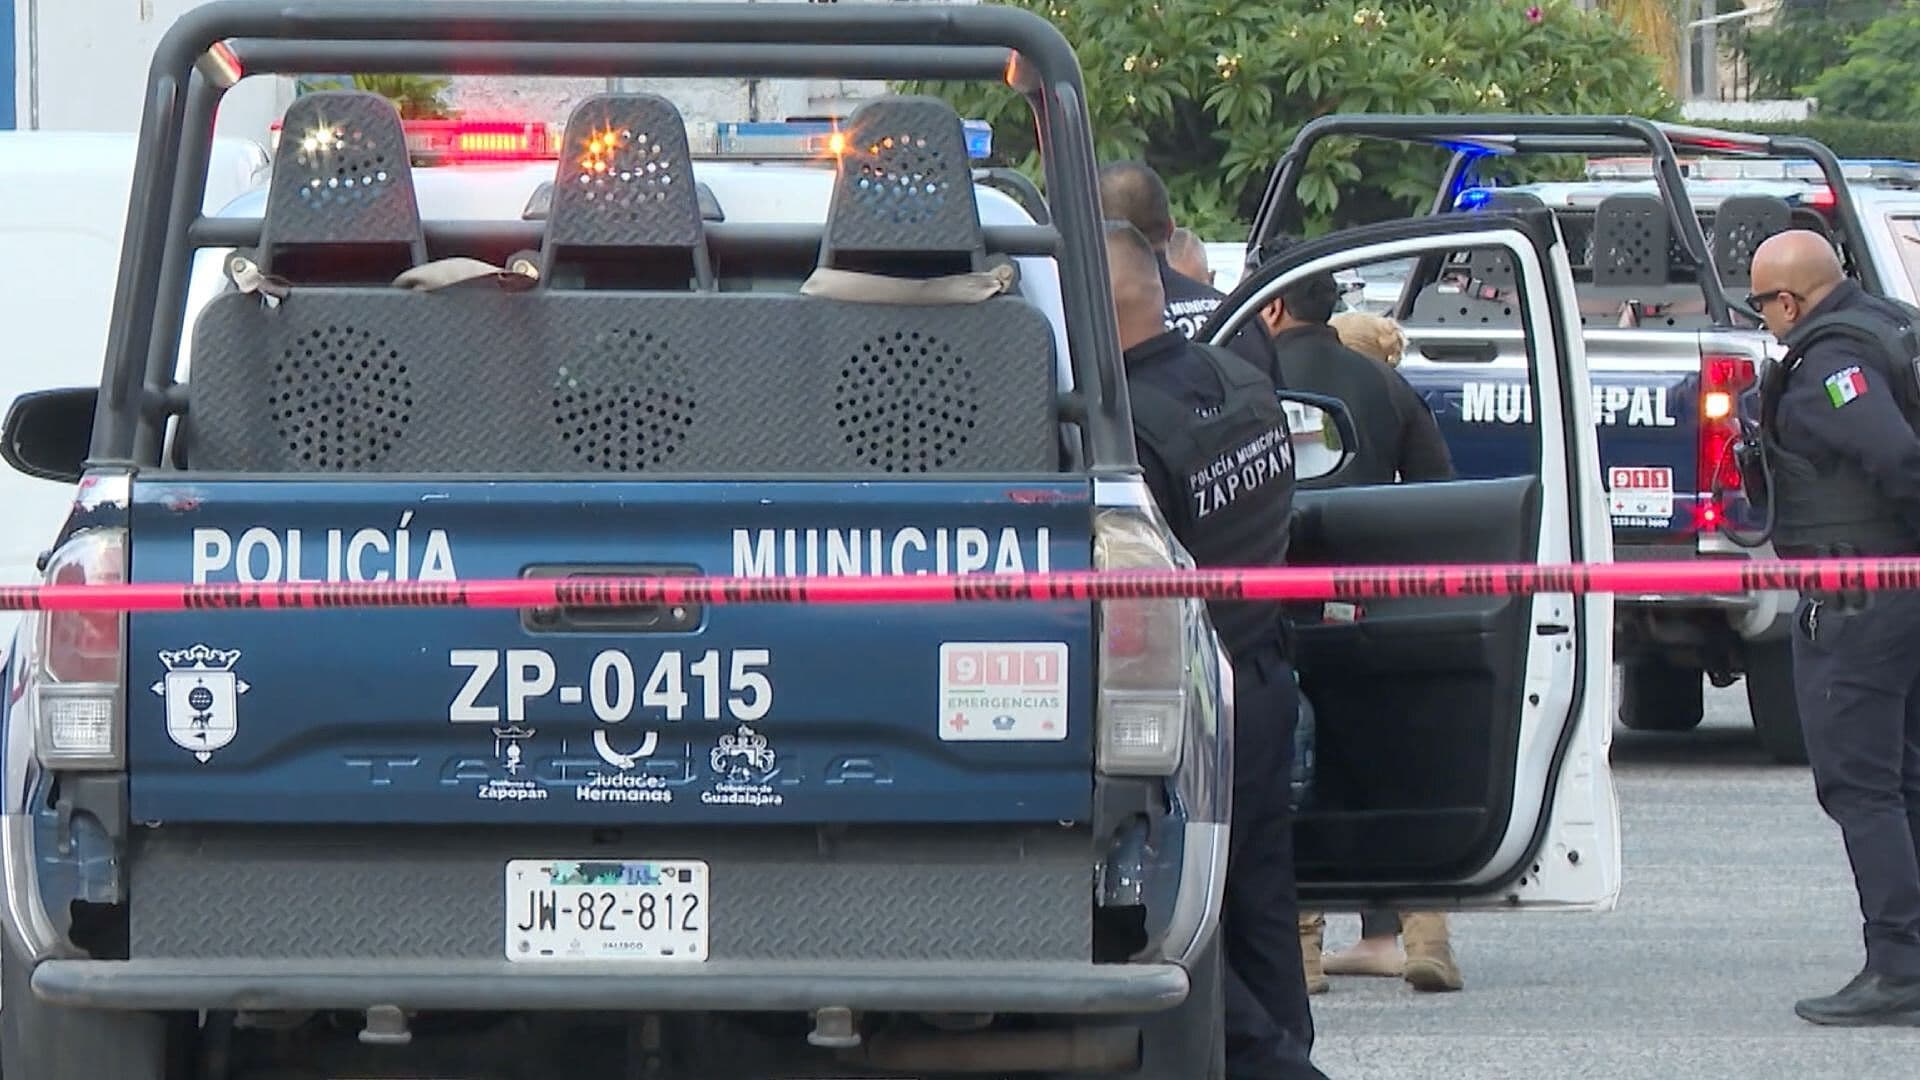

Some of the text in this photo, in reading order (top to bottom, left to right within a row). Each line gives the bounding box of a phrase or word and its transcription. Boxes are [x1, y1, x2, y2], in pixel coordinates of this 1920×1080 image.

[1190, 425, 1286, 490] POLICÍA MUNICIPAL
[1193, 442, 1292, 518] ZAPOPAN
[193, 511, 457, 583] POLICÍA
[956, 655, 1047, 681] 911
[450, 649, 773, 723] ZP-0415
[948, 697, 1059, 708] EMERGENCIAS
[478, 785, 547, 800] Zapopan
[576, 785, 672, 802] Hermanas
[701, 791, 783, 806] Guadalajara
[518, 890, 699, 931] JW-82-812
